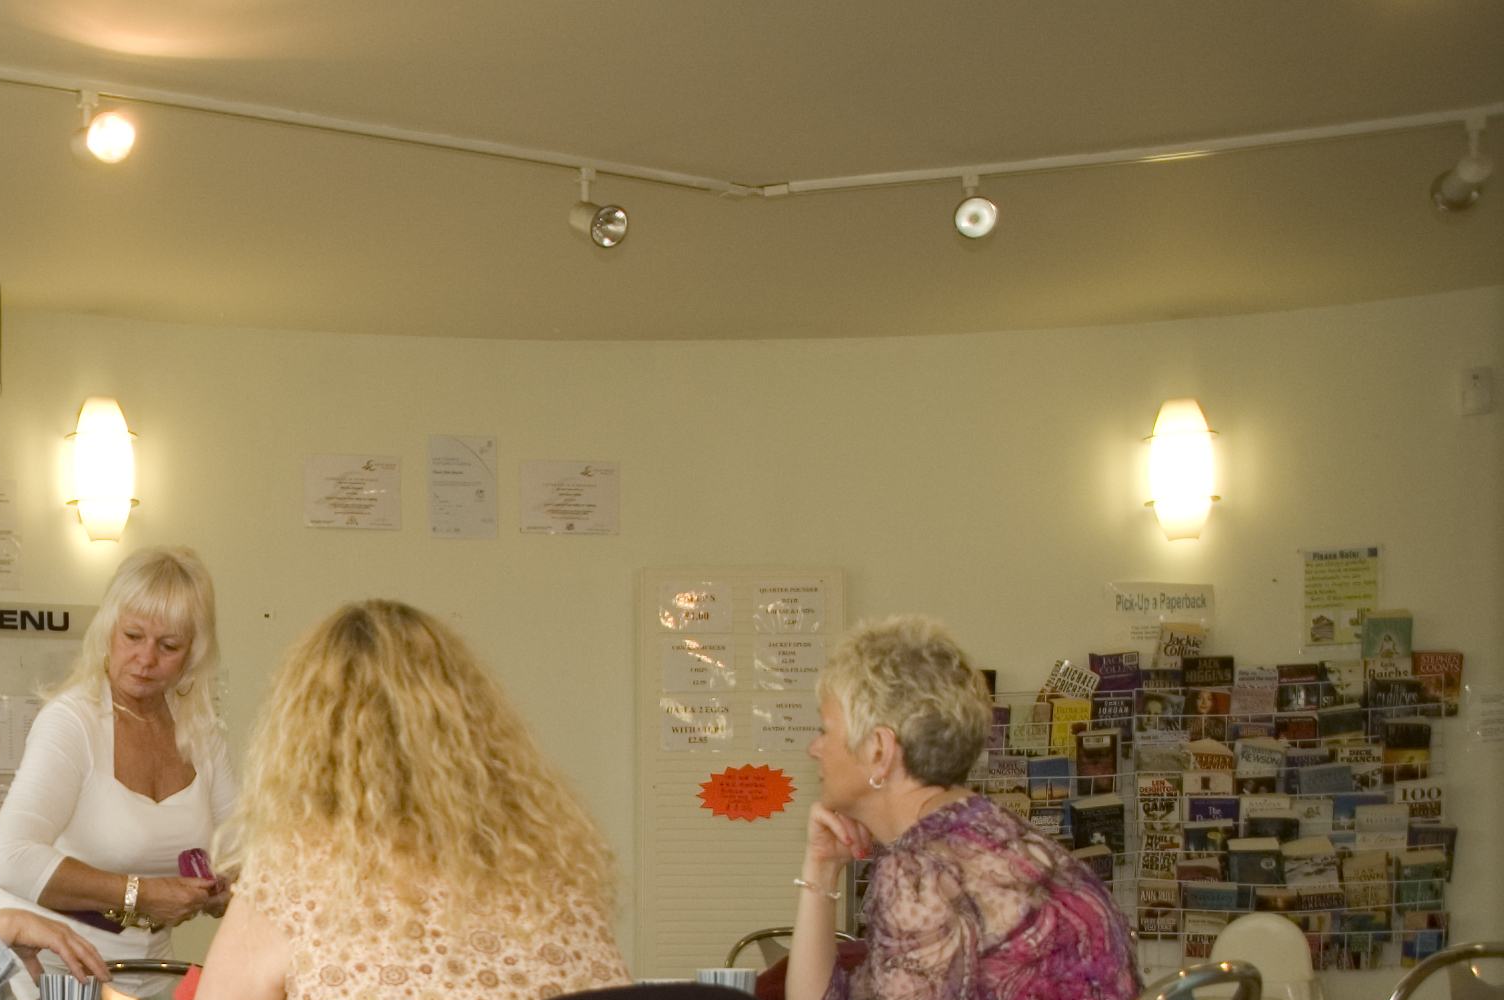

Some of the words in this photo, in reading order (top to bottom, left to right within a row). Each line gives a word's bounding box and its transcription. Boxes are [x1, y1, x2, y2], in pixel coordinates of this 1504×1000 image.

[1115, 592, 1149, 614] Pick-Up
[1152, 597, 1157, 609] a
[1159, 592, 1206, 613] Paperback
[1165, 632, 1202, 647] Jackie
[1184, 669, 1233, 683] HIGGINS
[1421, 663, 1461, 674] COONTS
[1063, 665, 1097, 692] MICHAEL
[1340, 755, 1382, 764] FRANCIS
[1400, 786, 1443, 803] 100
